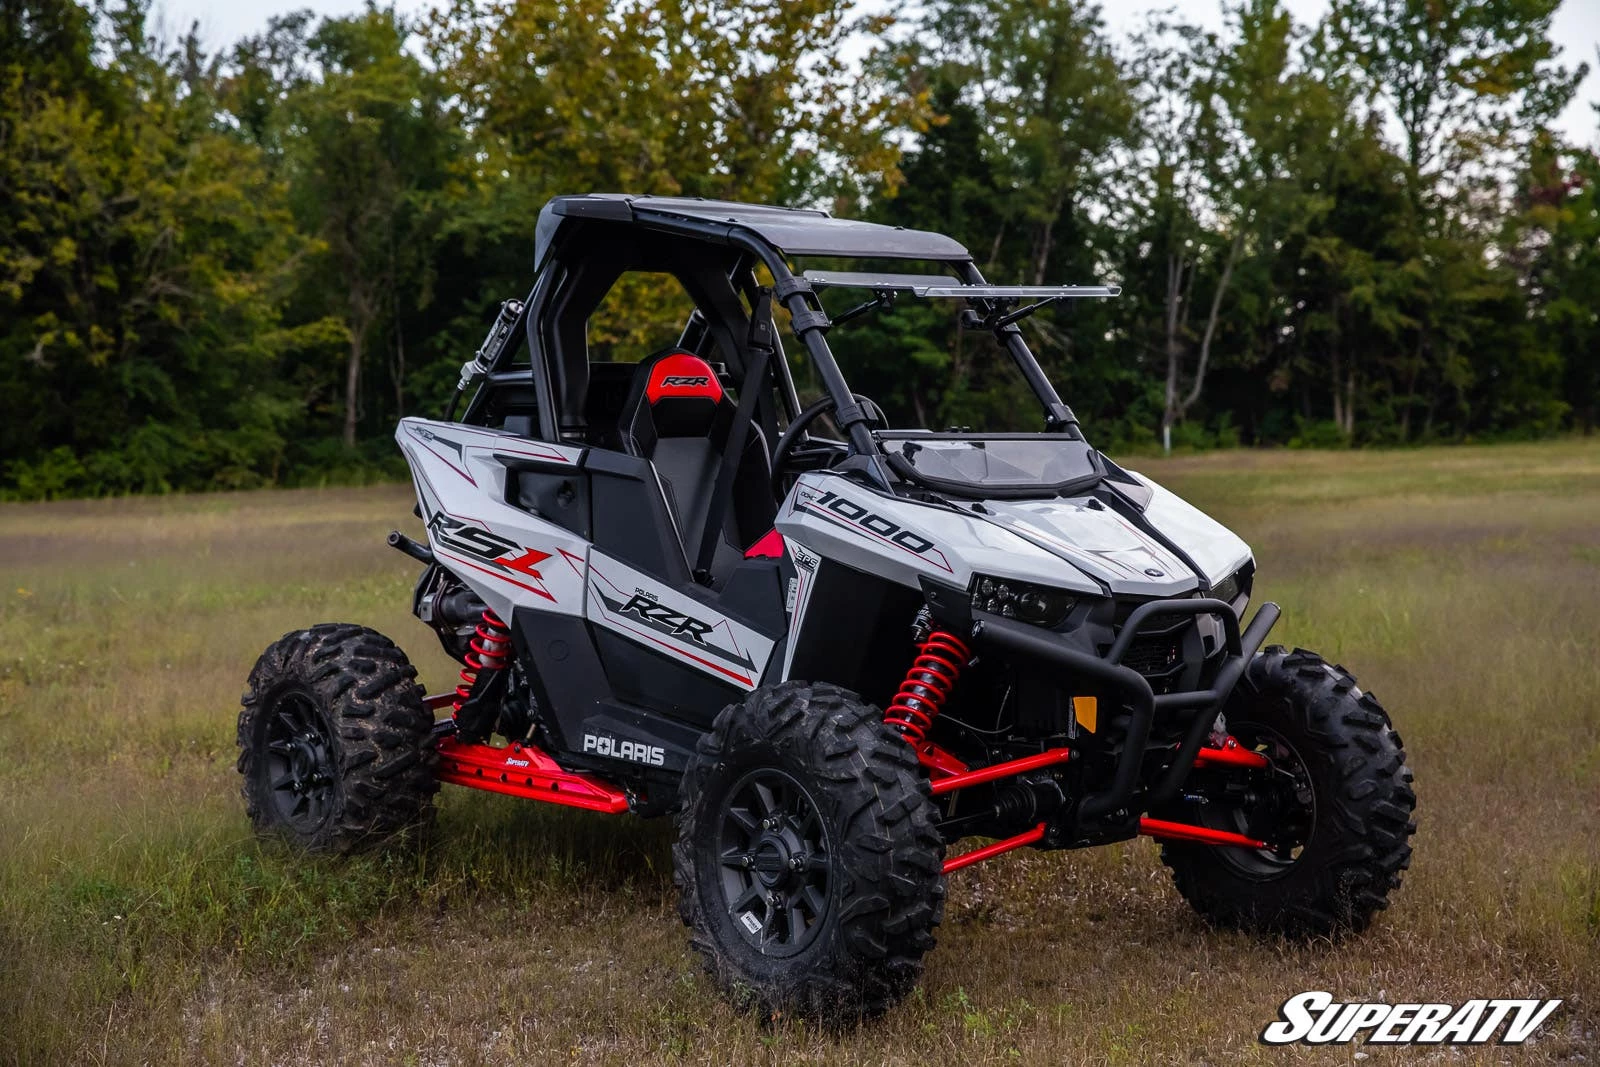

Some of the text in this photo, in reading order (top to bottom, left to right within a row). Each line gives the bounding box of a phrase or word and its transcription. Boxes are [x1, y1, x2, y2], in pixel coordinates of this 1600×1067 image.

[661, 376, 709, 387] RZR
[816, 491, 935, 554] 1000
[795, 550, 819, 568] EPS
[634, 587, 659, 602] POLARIS
[619, 594, 714, 647] RZR
[583, 734, 665, 766] POLARIS
